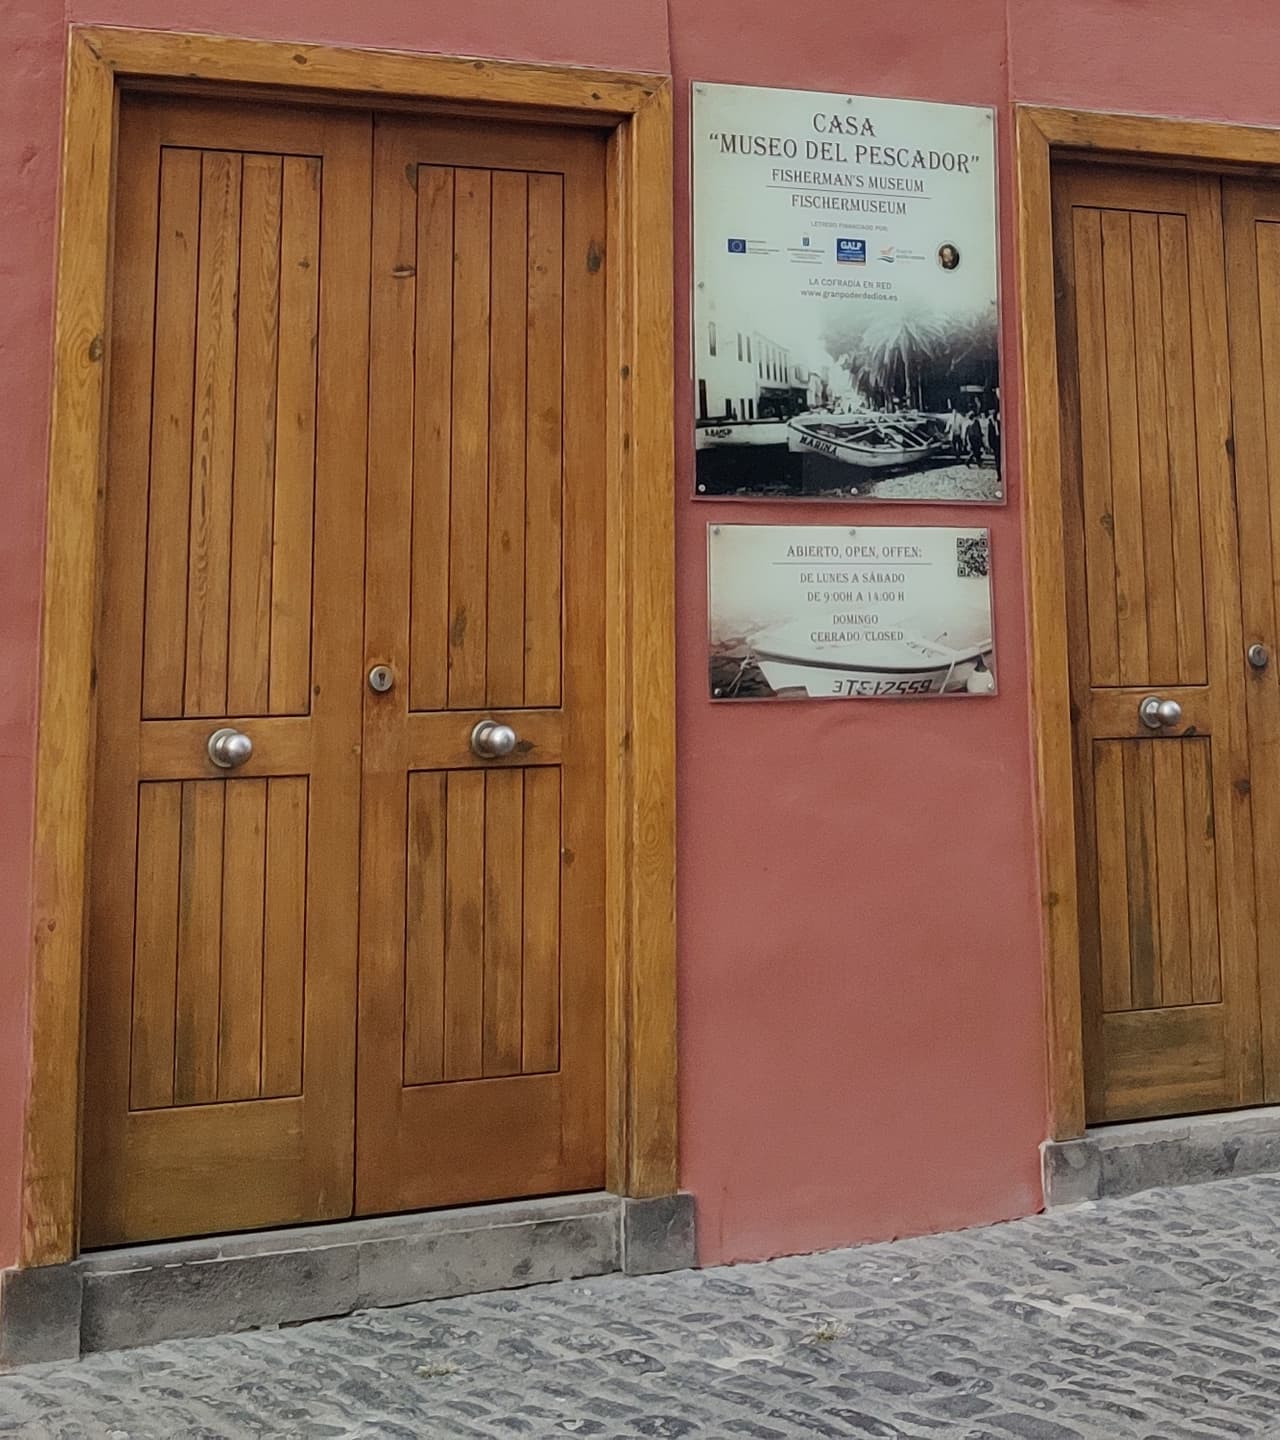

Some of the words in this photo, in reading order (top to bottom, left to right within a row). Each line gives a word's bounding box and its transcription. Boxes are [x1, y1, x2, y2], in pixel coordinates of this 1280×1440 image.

[813, 112, 877, 137] CASA
[806, 140, 847, 163] DEL
[868, 175, 924, 193] MUSEUM
[791, 194, 907, 215] FISCHERMUSEUM
[840, 241, 863, 251] GALP
[809, 278, 819, 286] LA
[863, 281, 874, 289] EN
[876, 281, 892, 290] RED
[800, 434, 837, 457] MARINA
[787, 545, 842, 560] ABIERTO,
[845, 545, 879, 559] OPEN,
[800, 572, 815, 584] DE
[816, 572, 849, 584] LUNES
[851, 572, 860, 584] A
[807, 591, 821, 603] DE
[855, 591, 864, 603] A
[898, 591, 905, 602] H
[832, 614, 879, 626] DOMINGO
